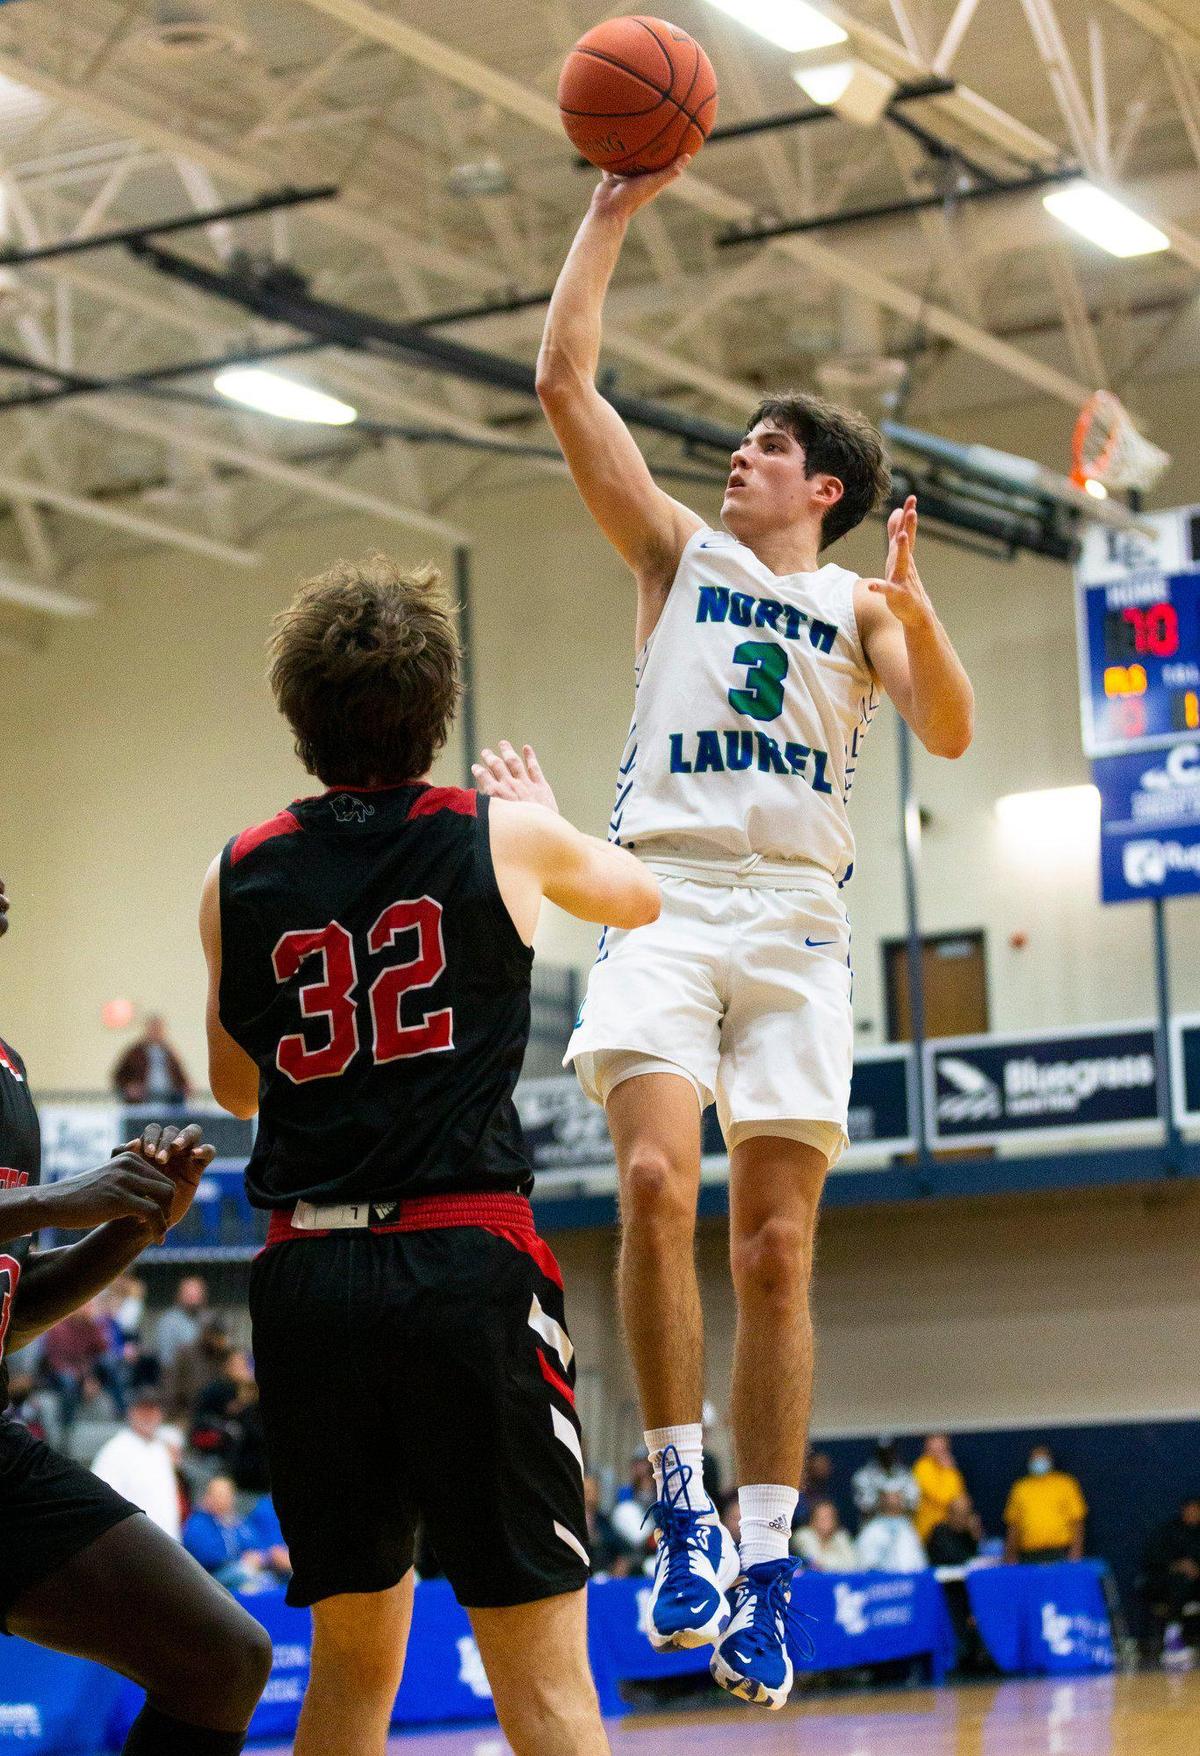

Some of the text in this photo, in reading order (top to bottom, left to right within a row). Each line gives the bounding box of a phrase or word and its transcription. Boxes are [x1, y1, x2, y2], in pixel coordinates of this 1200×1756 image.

[696, 586, 838, 655] NORTH
[728, 640, 789, 722] 3
[669, 730, 832, 794] LAUREL
[271, 895, 455, 1085] 32
